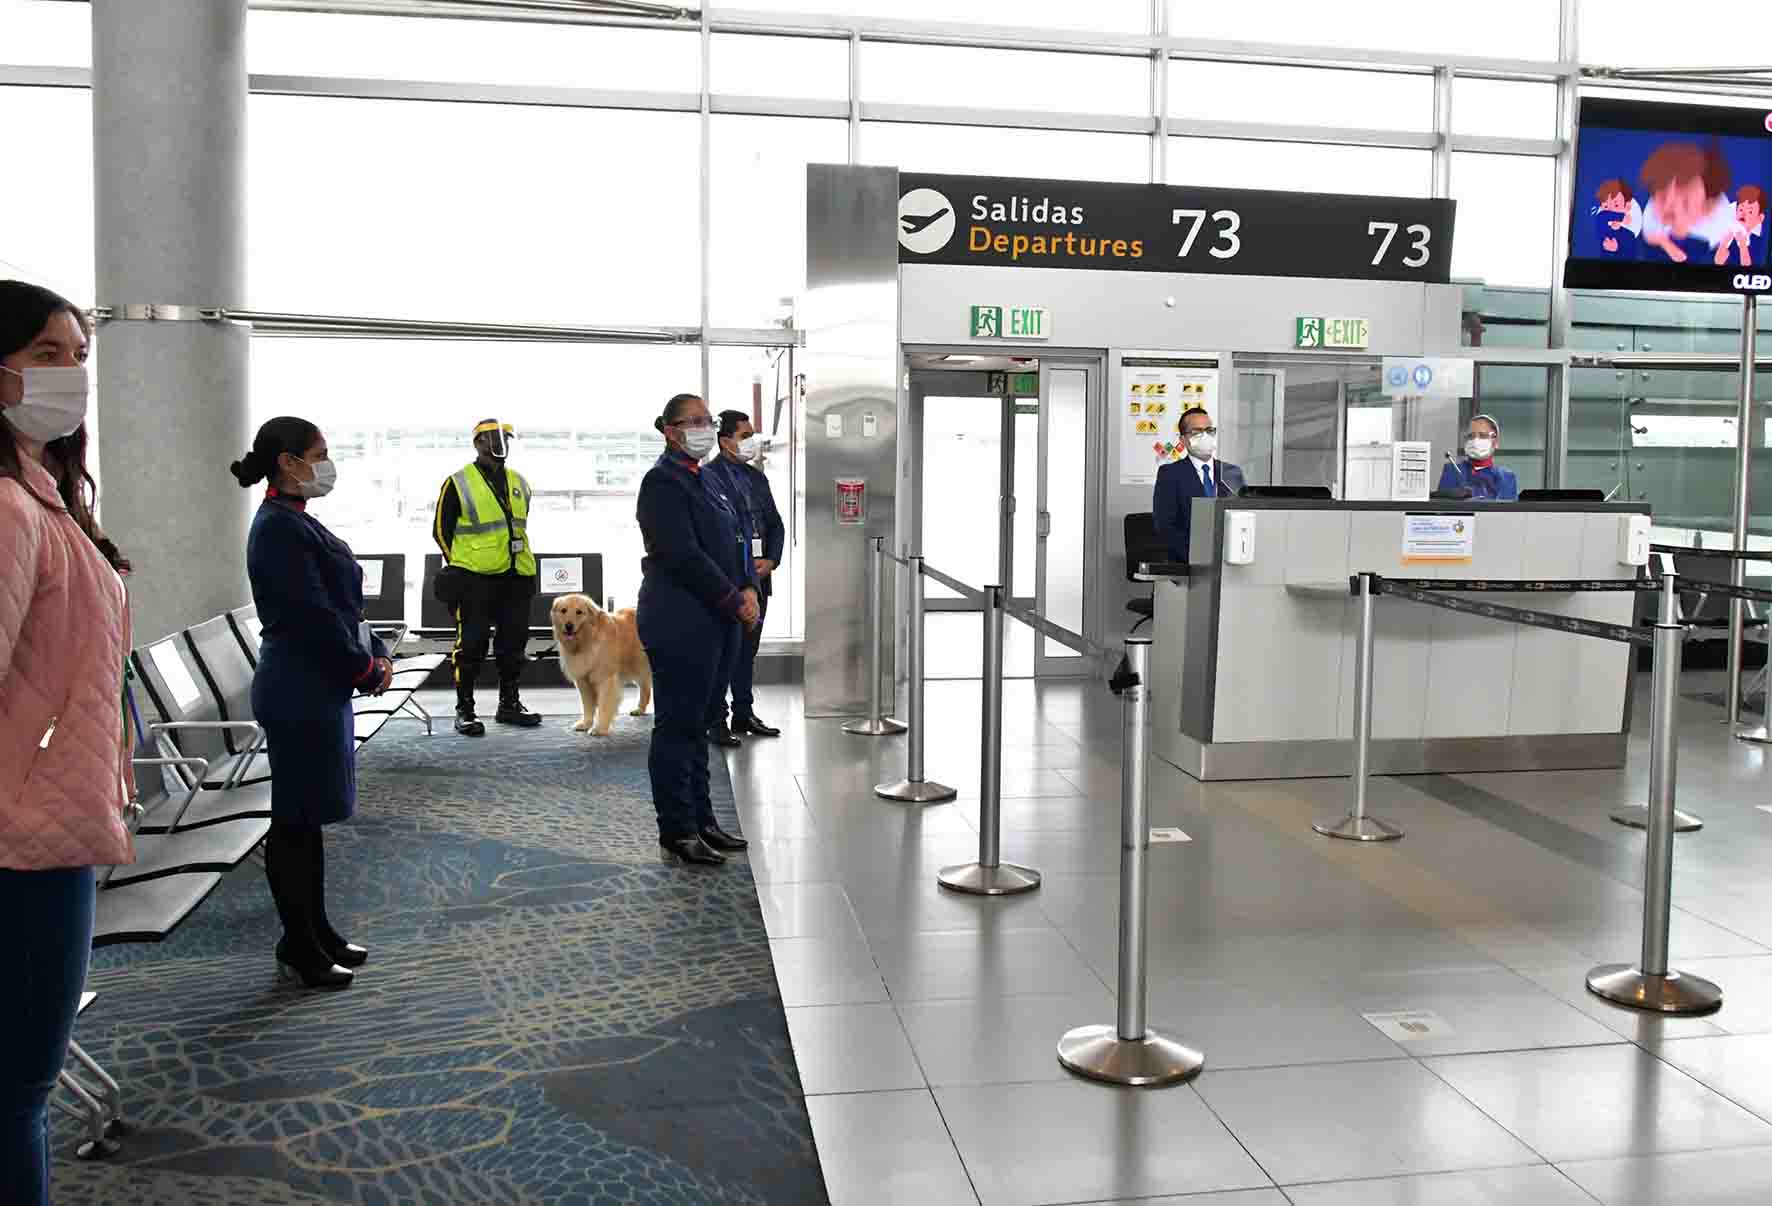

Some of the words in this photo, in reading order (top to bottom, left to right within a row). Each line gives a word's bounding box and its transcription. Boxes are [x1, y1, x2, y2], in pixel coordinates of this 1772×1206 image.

[971, 195, 1084, 225] Salidas
[969, 227, 1144, 260] Departures
[1172, 209, 1242, 259] 73
[1367, 221, 1431, 267] 73
[1733, 273, 1772, 290] OLED
[1011, 309, 1043, 335] EXIT
